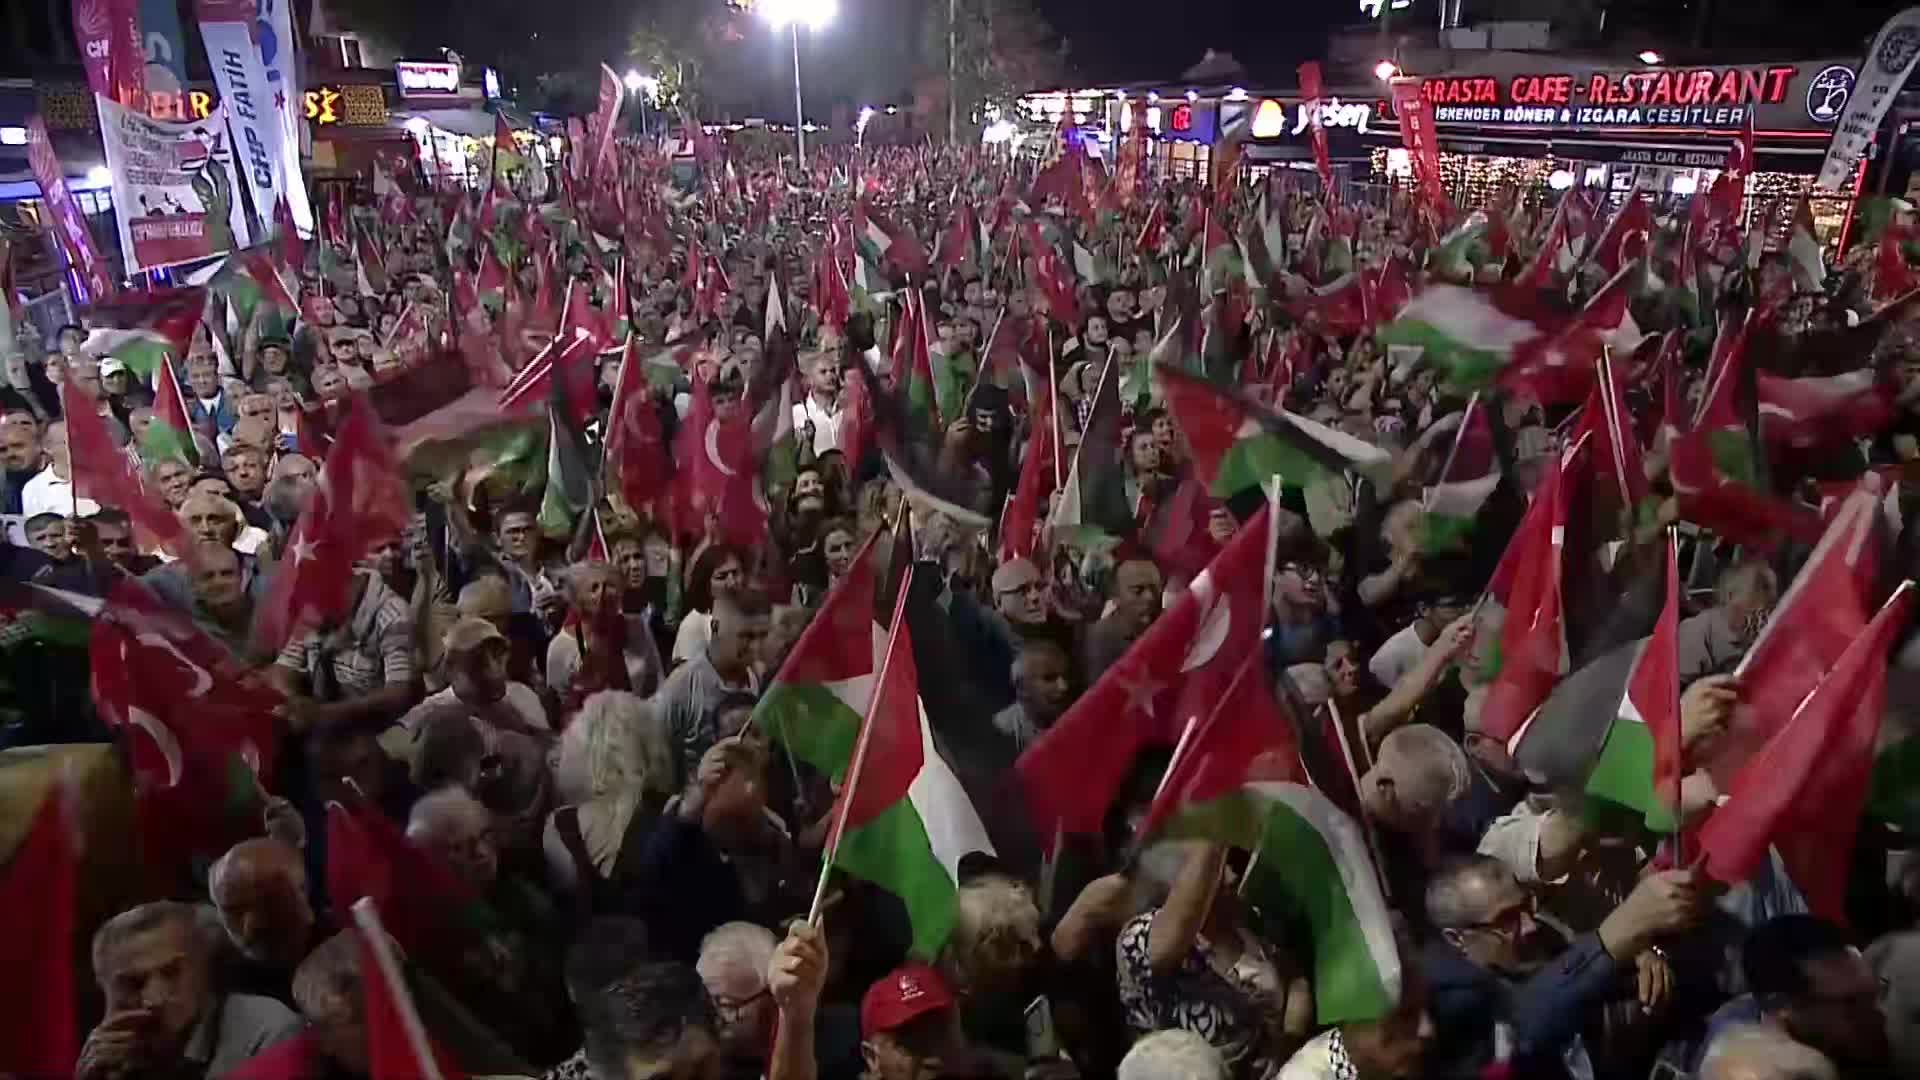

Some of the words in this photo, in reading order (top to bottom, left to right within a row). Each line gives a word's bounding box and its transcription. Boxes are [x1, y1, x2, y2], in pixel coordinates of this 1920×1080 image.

[86, 39, 110, 58] CH
[1421, 78, 1497, 103] ARASTA
[1511, 76, 1573, 103] CAFE
[1589, 67, 1797, 105] RESTAURANT
[1504, 105, 1556, 123] DÖNER
[244, 126, 273, 189] CHP
